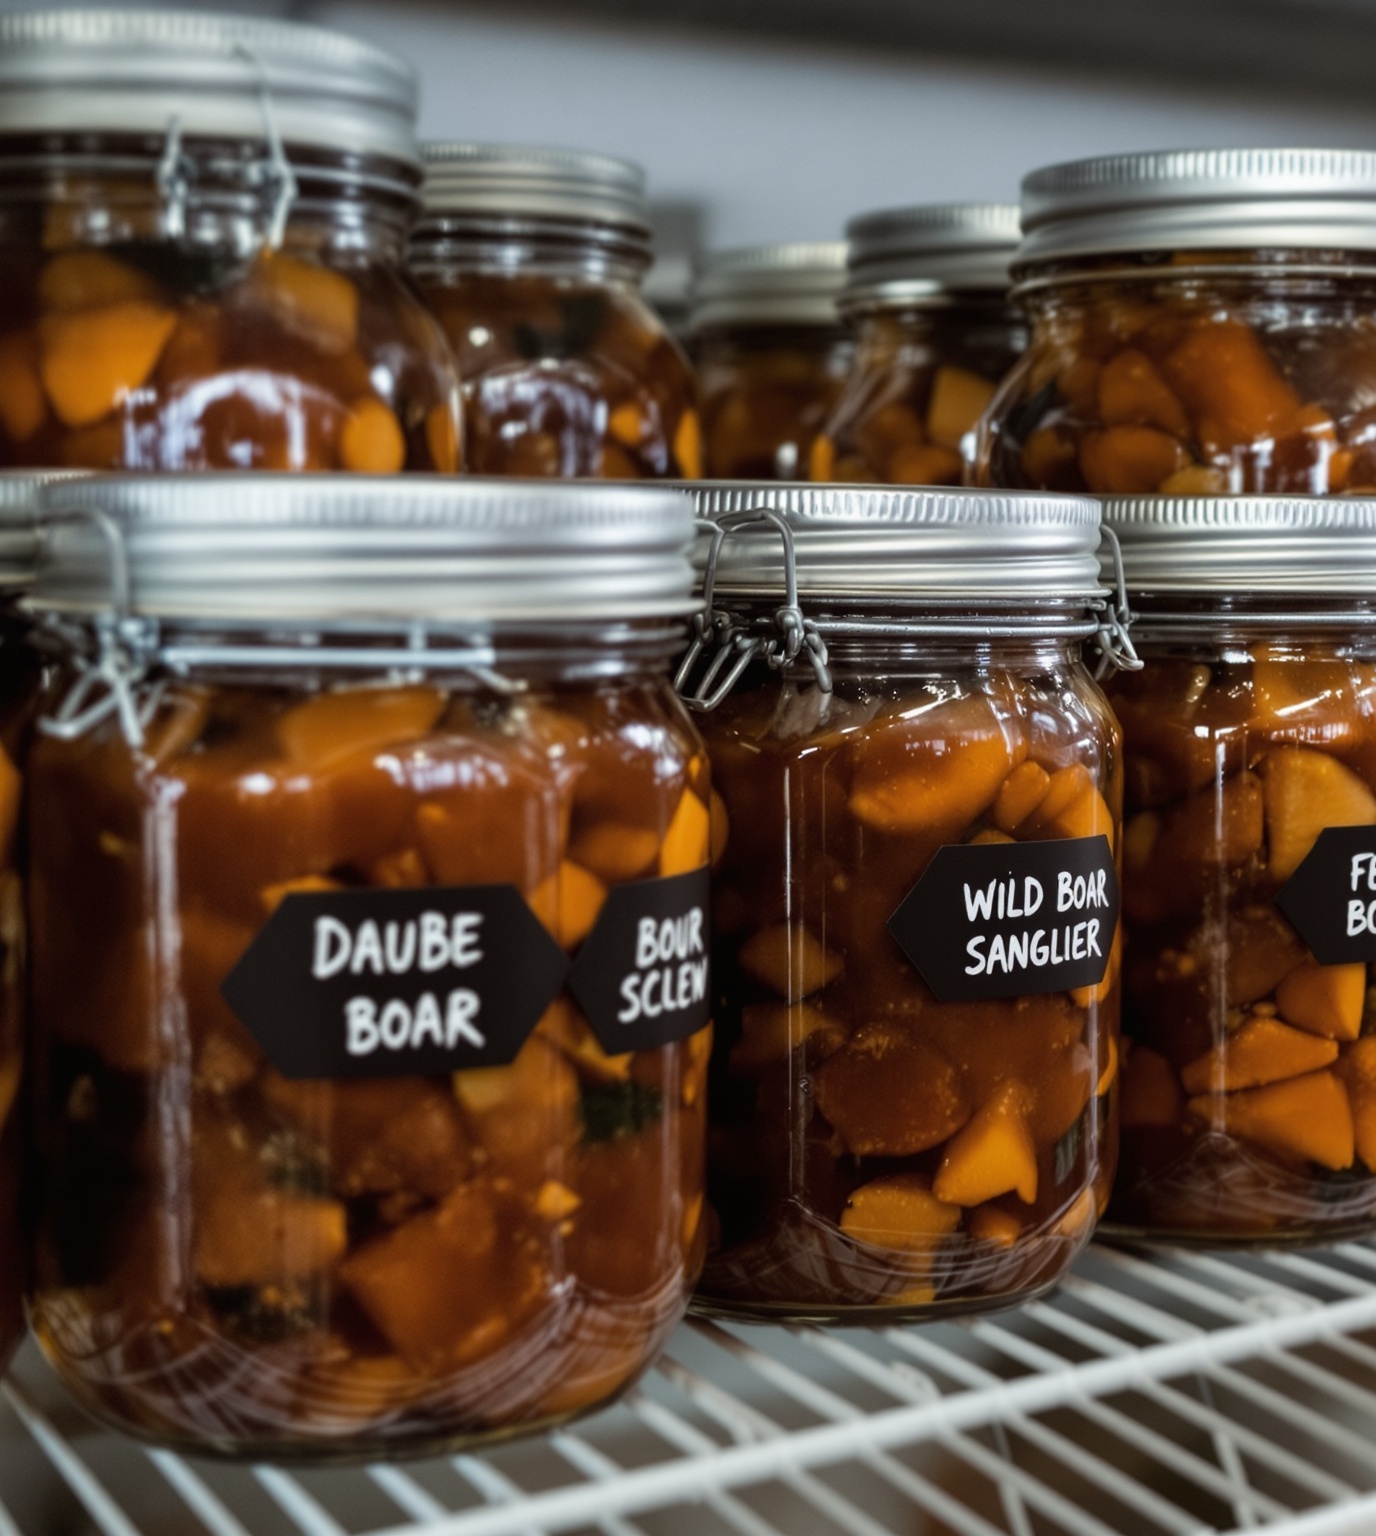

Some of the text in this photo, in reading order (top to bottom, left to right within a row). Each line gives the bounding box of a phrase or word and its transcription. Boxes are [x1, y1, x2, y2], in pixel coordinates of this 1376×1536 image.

[963, 868, 1109, 922] WILD BOAR
[312, 911, 484, 980] DAUBE
[636, 906, 704, 969] BOUR
[964, 918, 1102, 975] SANGLIER
[345, 988, 485, 1056] BOAR
